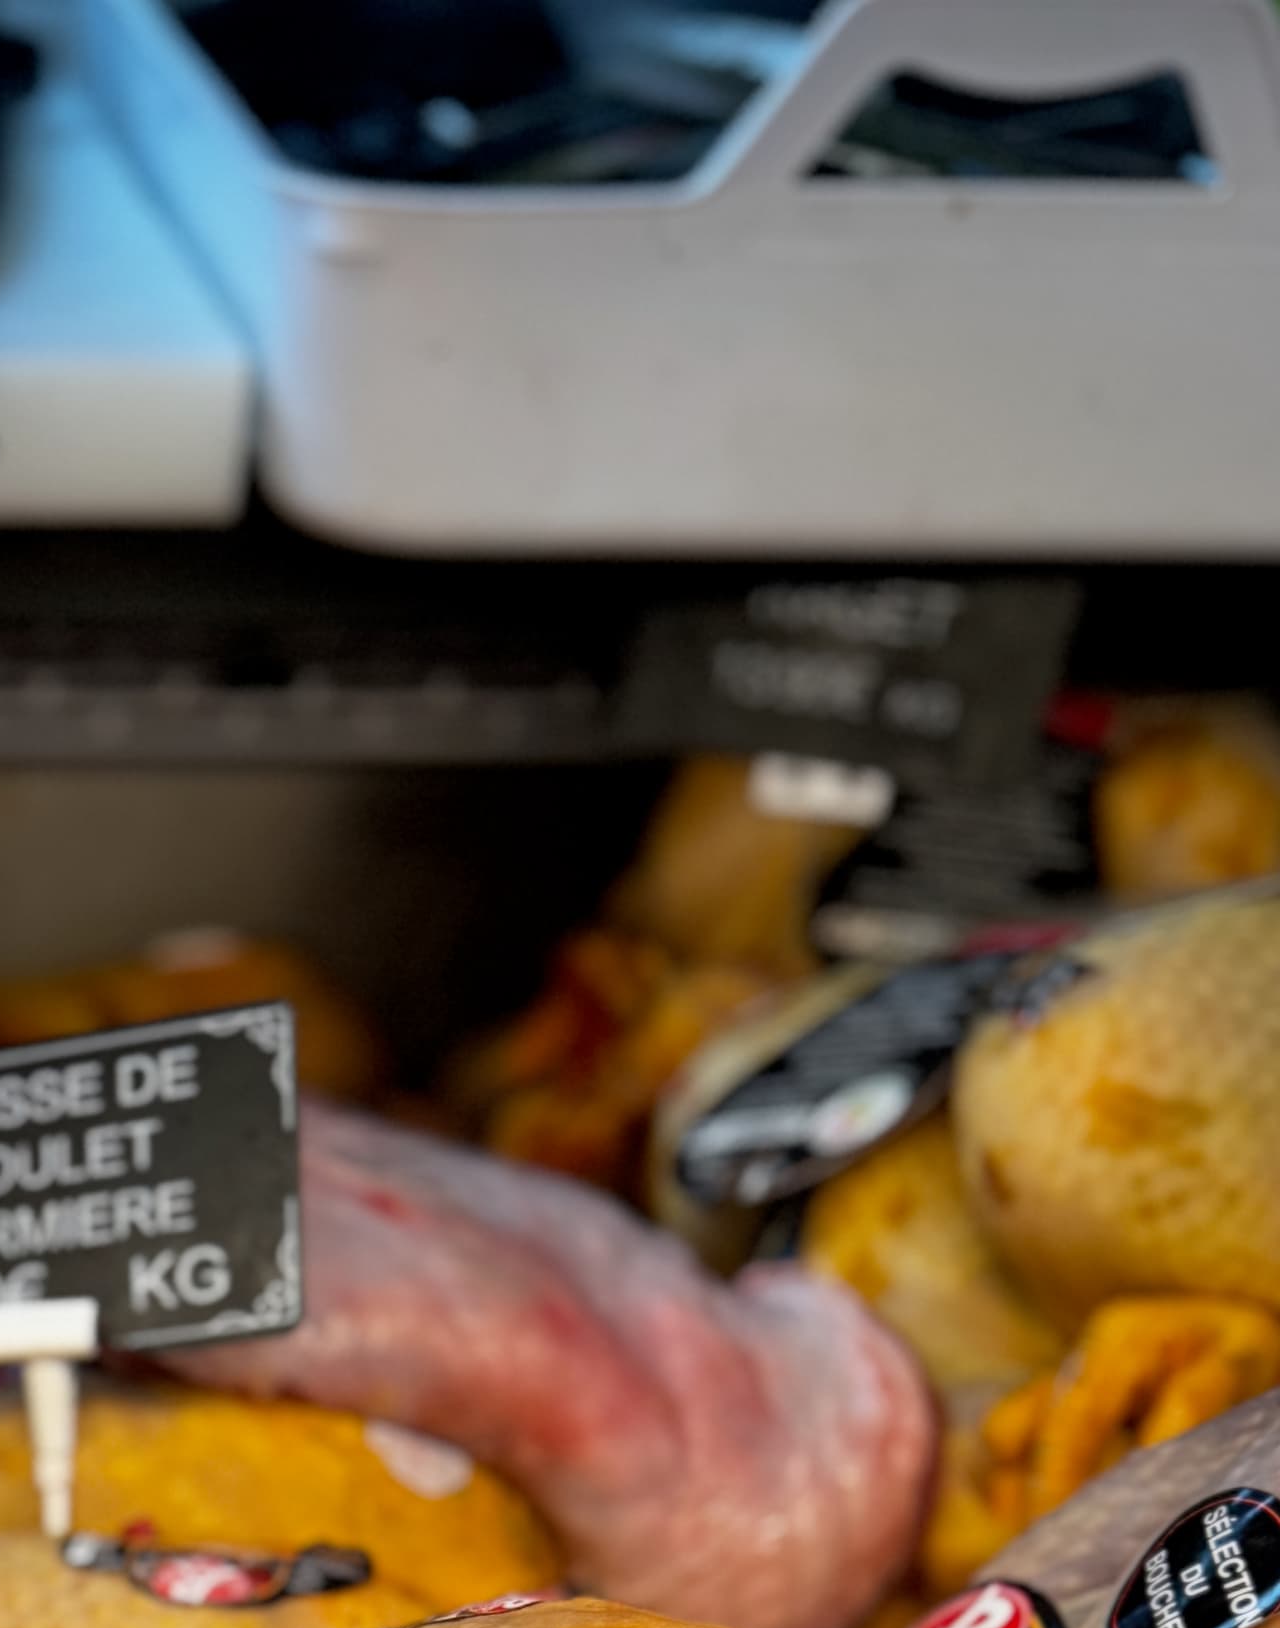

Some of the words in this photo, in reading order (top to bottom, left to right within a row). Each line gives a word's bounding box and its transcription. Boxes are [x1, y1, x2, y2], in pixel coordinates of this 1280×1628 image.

[116, 1044, 199, 1109] DE
[129, 1244, 232, 1311] KG
[1177, 1563, 1210, 1597] DU
